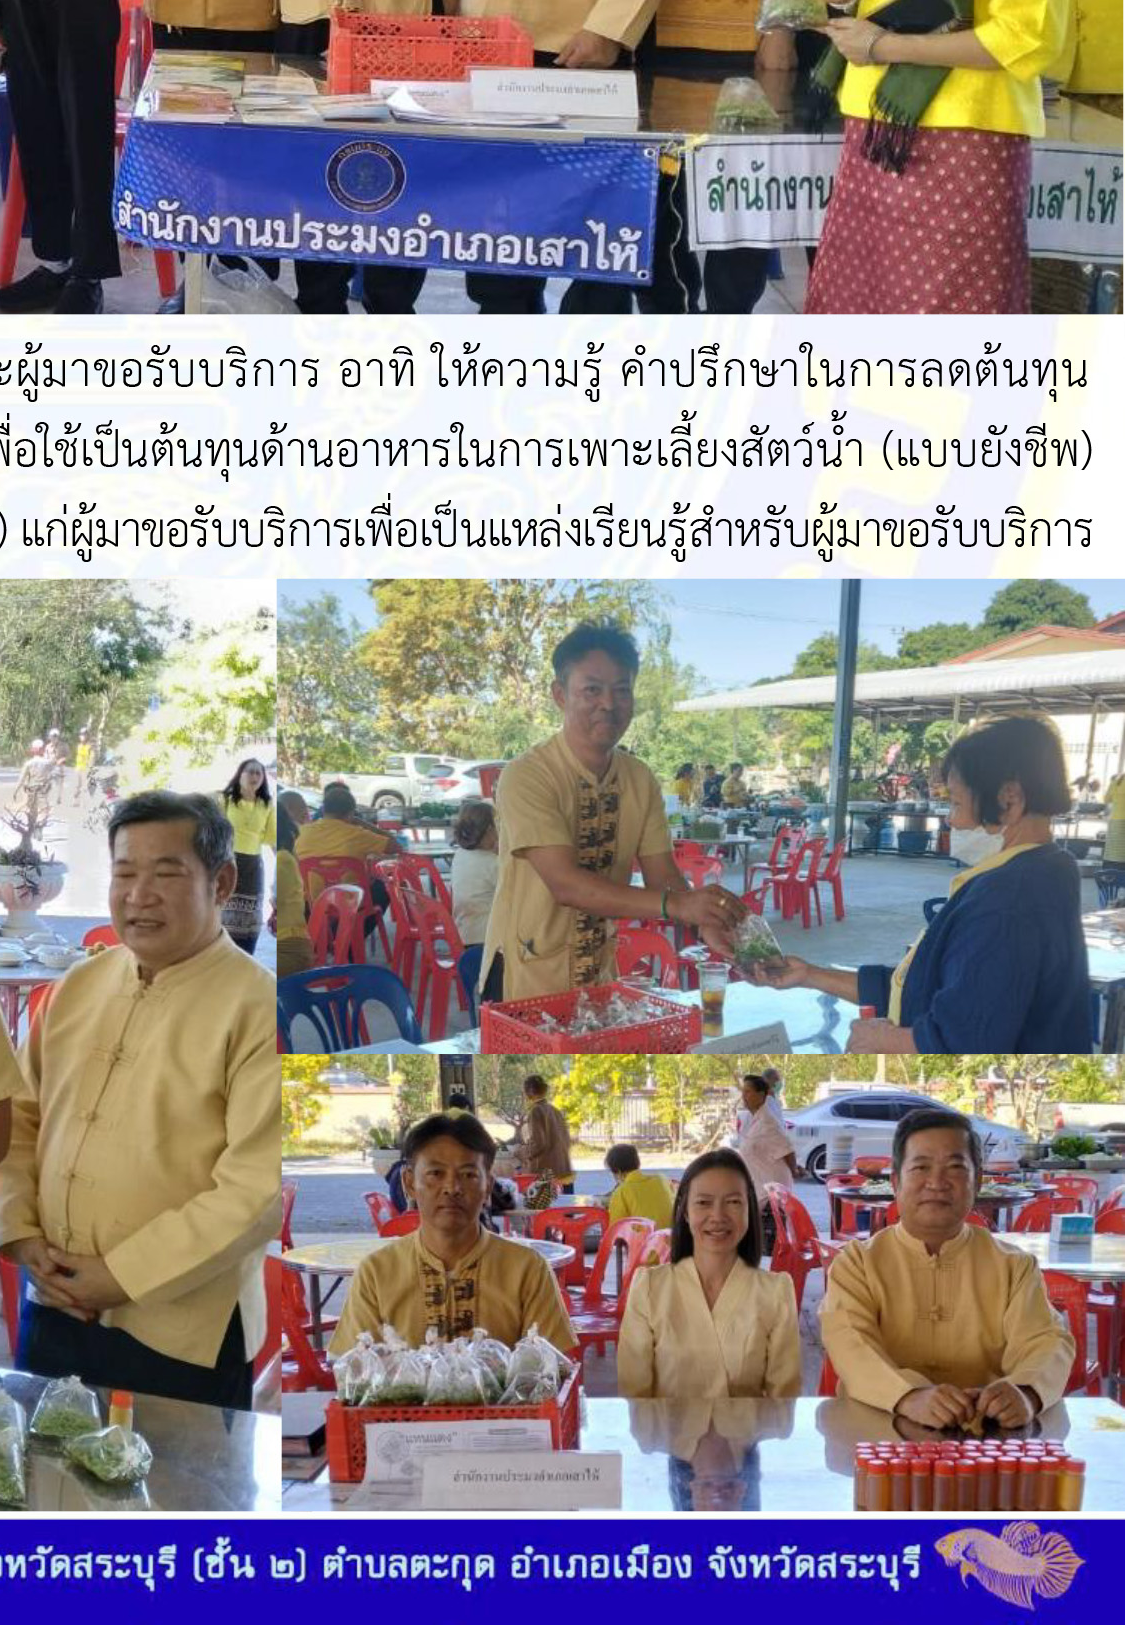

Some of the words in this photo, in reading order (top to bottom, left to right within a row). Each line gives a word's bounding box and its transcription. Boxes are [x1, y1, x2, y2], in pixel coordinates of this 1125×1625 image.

[117, 190, 644, 275] สำนักงานประมงอำเภอเสาไห้
